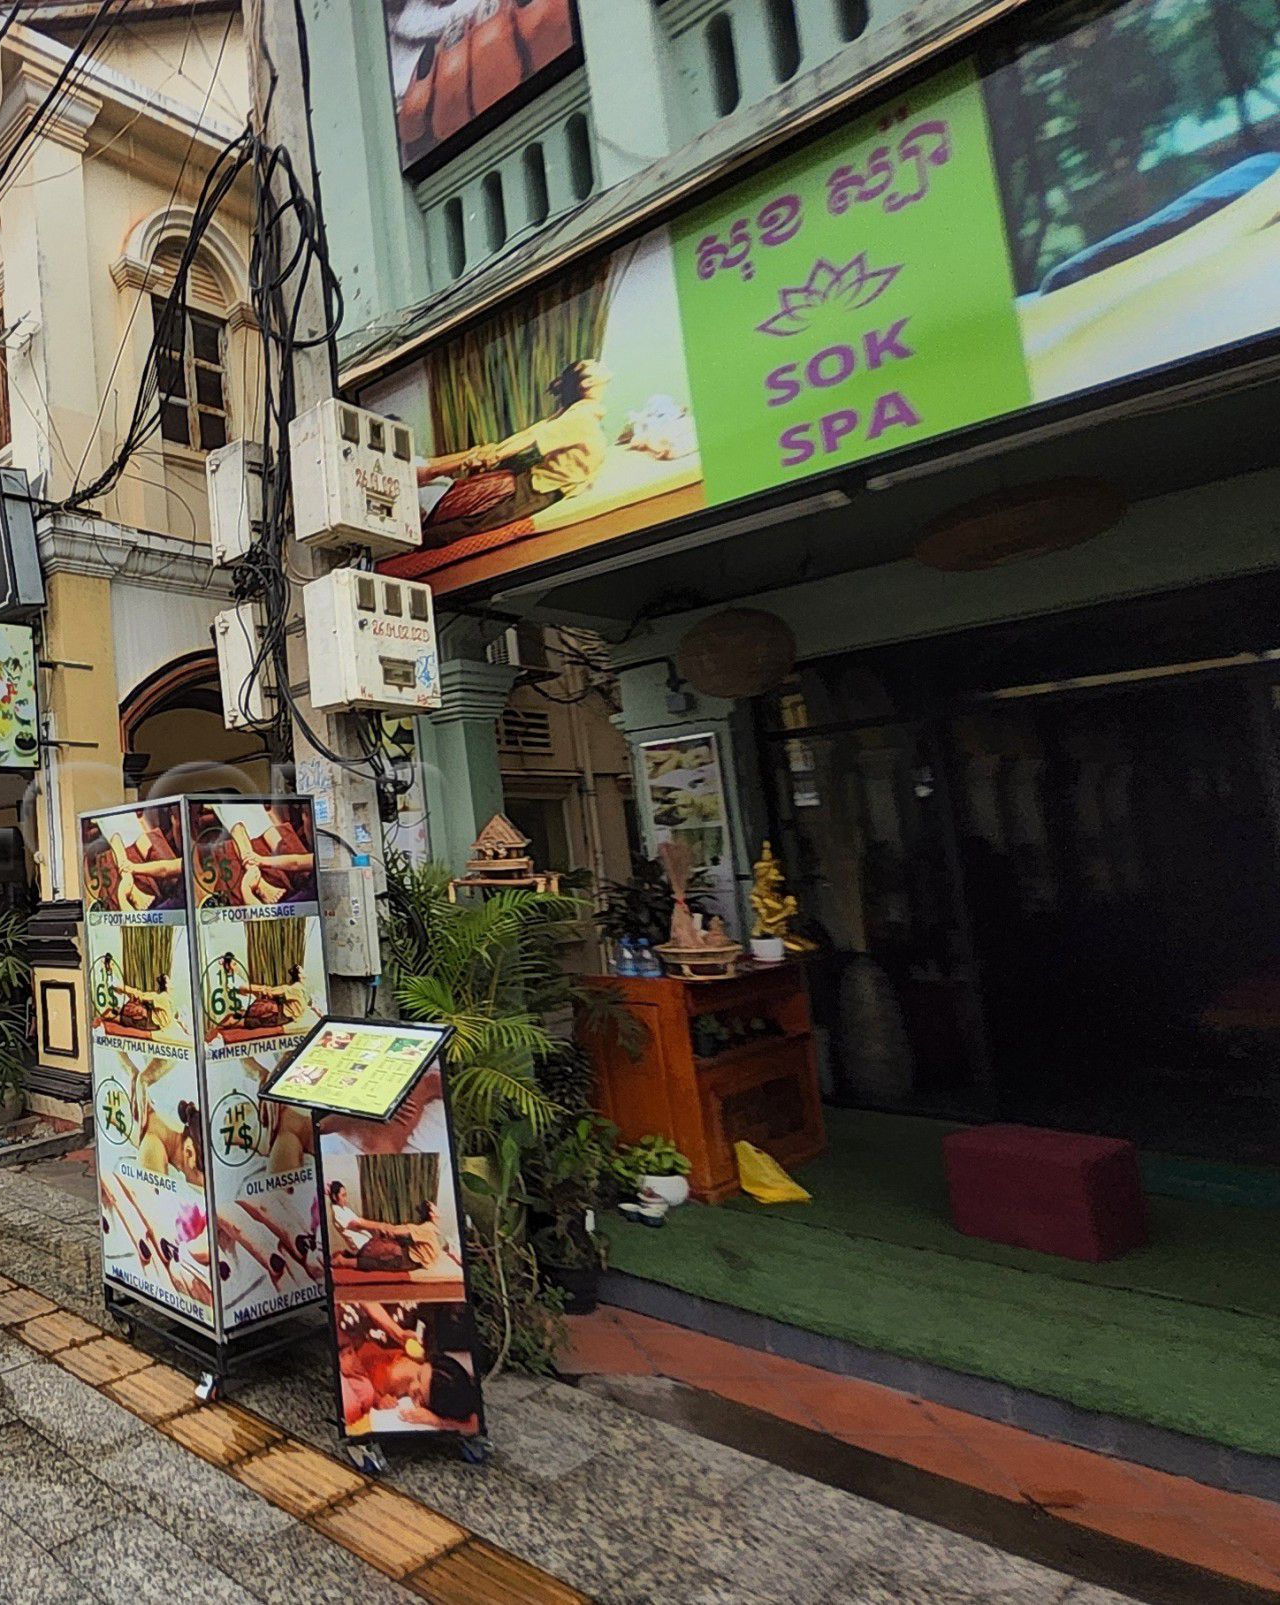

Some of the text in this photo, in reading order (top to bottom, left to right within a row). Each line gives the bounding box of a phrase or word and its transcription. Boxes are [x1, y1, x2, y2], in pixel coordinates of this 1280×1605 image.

[765, 315, 914, 407] SOK
[779, 391, 923, 468] SPA
[103, 913, 163, 925] FOOT MASSAGE
[222, 905, 295, 921] FOOT MASSAGE
[96, 984, 119, 1008] 6$
[211, 986, 243, 1015] 6$
[147, 1044, 189, 1060] MASSAGE
[107, 1090, 121, 1106] 1H
[102, 1105, 126, 1137] 7$
[226, 1107, 245, 1124] 1H
[220, 1125, 253, 1155] 7$
[121, 1164, 177, 1193] OIL MASSAGE
[246, 1168, 313, 1195] OIL MASSAGE
[111, 1265, 205, 1320] MANICURE/PEDICURE
